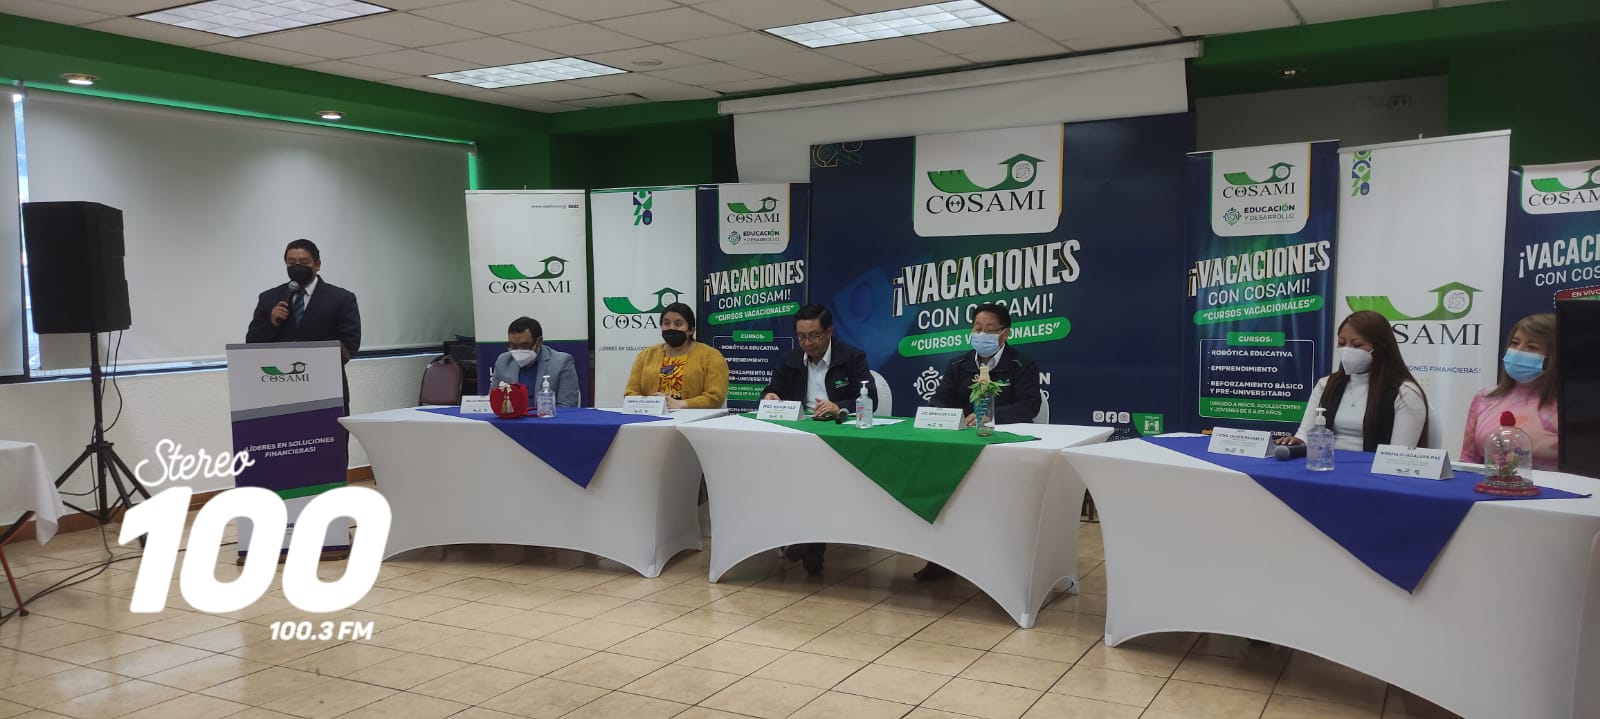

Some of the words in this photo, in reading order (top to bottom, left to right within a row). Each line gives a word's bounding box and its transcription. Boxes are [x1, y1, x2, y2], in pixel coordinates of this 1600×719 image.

[1223, 182, 1295, 198] COSAMI
[926, 190, 1047, 214] COSAMI
[1244, 203, 1295, 214] EDUCACIÓN
[727, 213, 780, 223] COSAMI
[1188, 240, 1331, 297] ¡VACACIONES
[703, 259, 804, 302] ¡VACACIONES
[893, 239, 1081, 317] ¡VACACIONES
[1535, 270, 1567, 286] CON
[488, 280, 571, 294] COSAMI
[1208, 289, 1239, 306] CON
[1244, 278, 1310, 300] COSAMI!
[718, 296, 741, 309] CON
[744, 289, 791, 306] COSAMI!
[918, 306, 959, 330] CON
[966, 293, 1054, 323] CAMI!
[602, 315, 657, 329] COSA
[1392, 323, 1484, 345] SAMI
[1211, 349, 1249, 357] ROBÓTICA
[1211, 365, 1278, 373] EMPRENDIMIENTO
[1430, 366, 1482, 374] FINANCIERAS!
[261, 374, 310, 382] COSAMI
[1210, 381, 1274, 389] REFORZAMIENTO
[1275, 381, 1304, 390] BÁSICO
[1215, 388, 1291, 397] PRE-UNIVERSITARIO
[288, 436, 335, 447] SOLUCIONES
[265, 446, 316, 457] FINANCIERAS!
